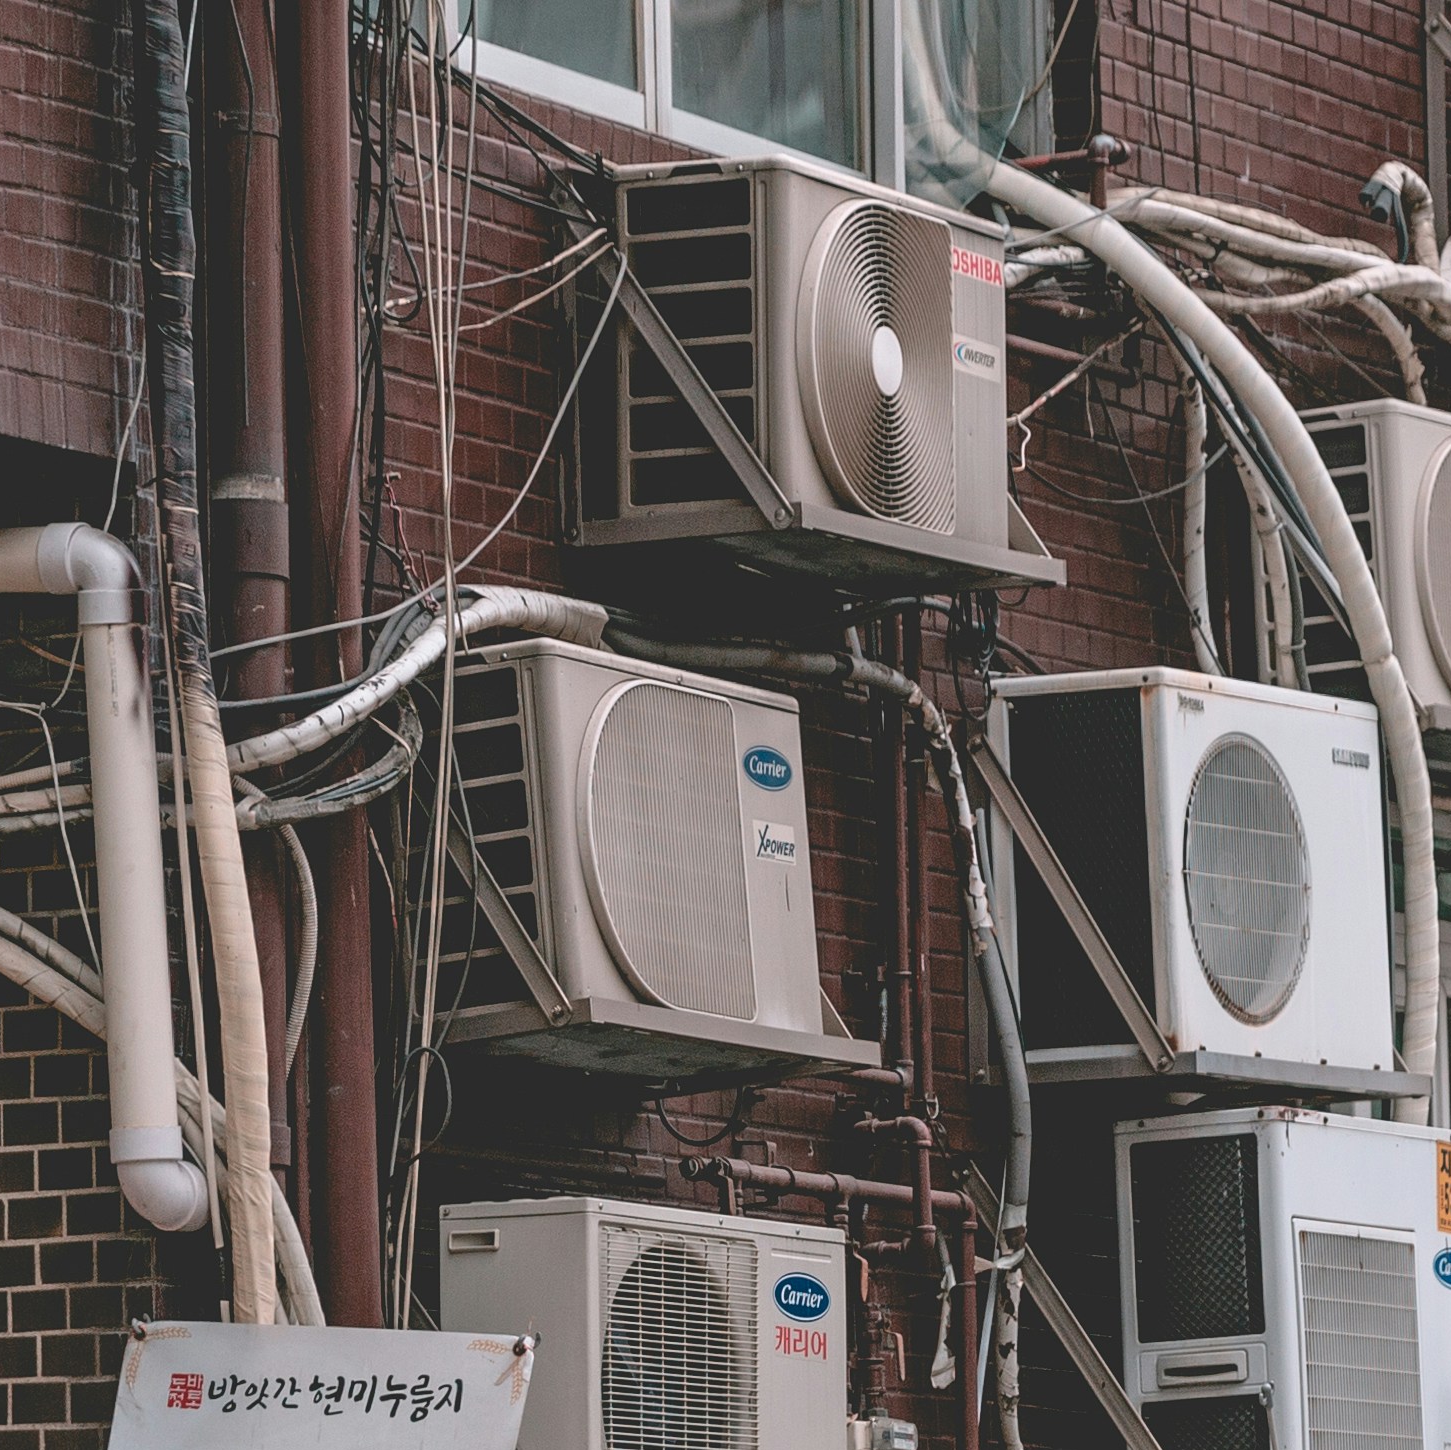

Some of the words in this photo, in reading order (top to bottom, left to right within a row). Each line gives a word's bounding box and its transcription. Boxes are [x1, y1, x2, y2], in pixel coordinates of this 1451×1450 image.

[963, 347, 996, 369] INVERTER
[749, 755, 788, 778] Carrier
[779, 1284, 825, 1310] Carrier
[775, 1324, 828, 1360] 캐리어
[208, 1374, 302, 1413] 방앗간
